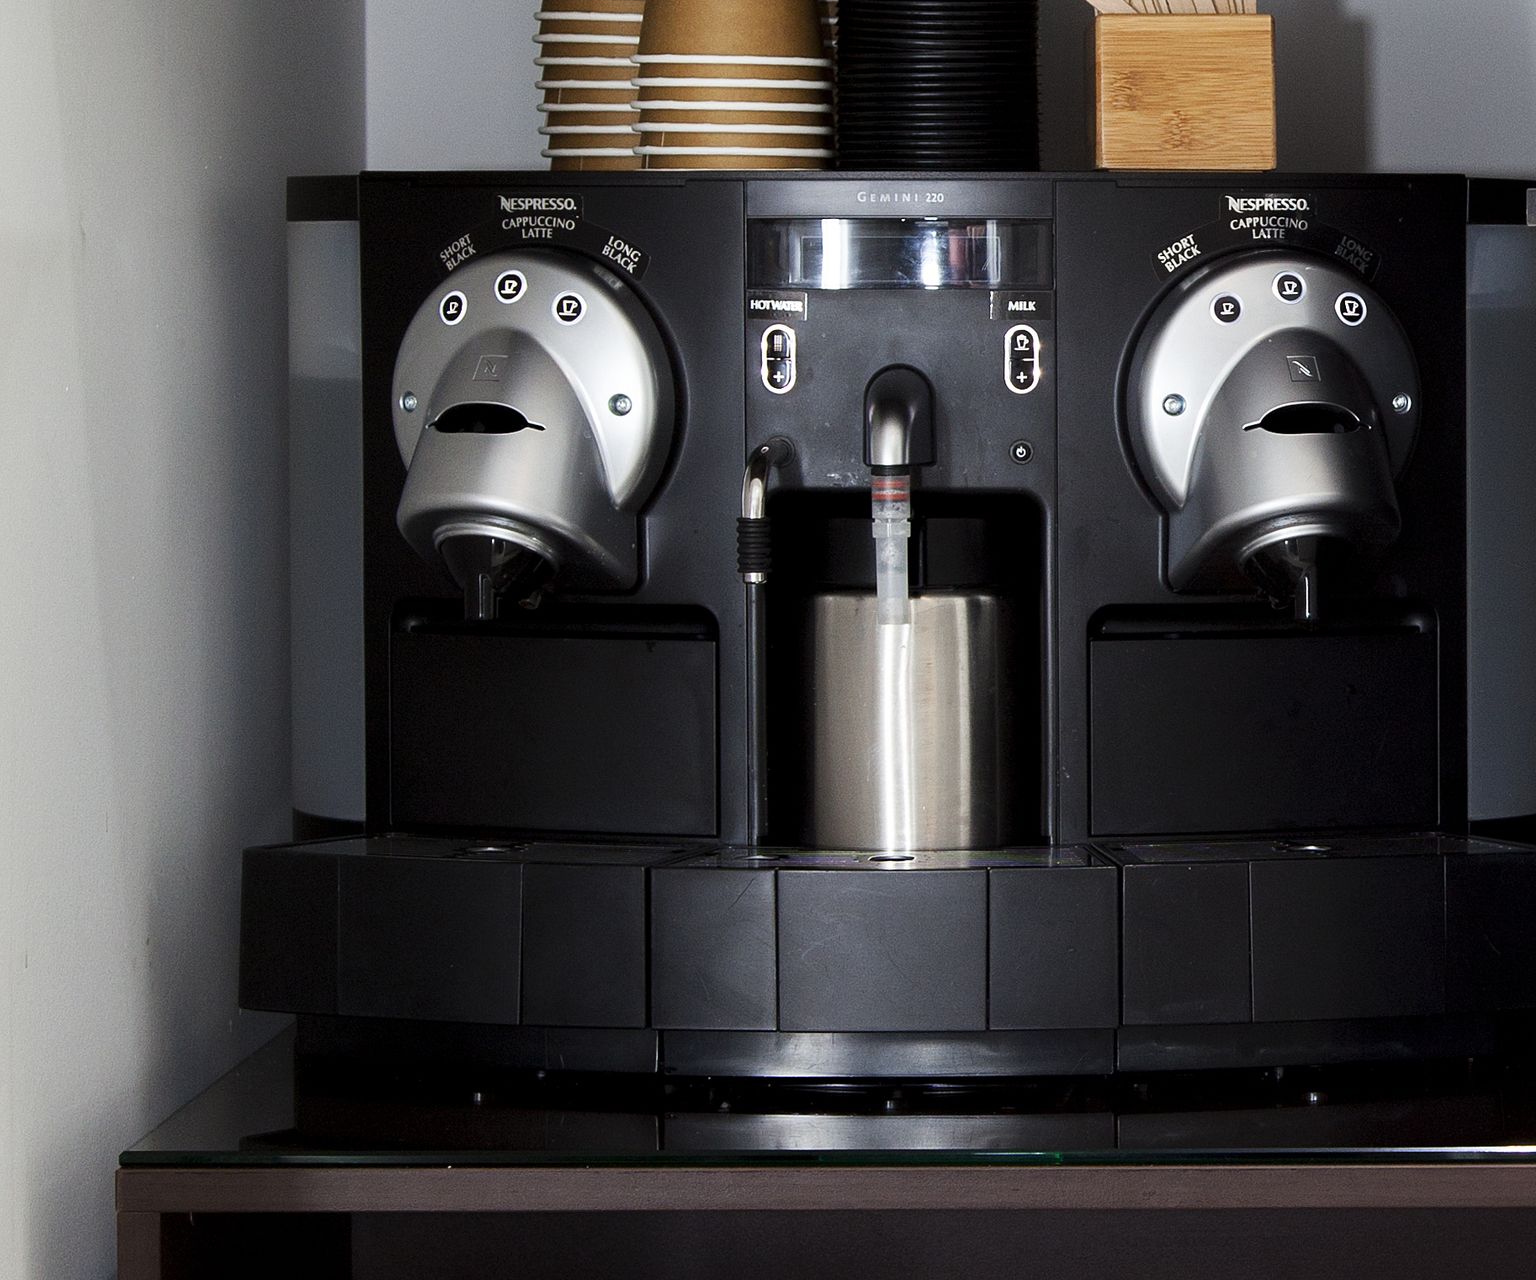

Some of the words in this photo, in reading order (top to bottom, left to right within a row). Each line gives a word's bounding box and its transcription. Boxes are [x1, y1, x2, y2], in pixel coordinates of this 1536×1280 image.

[857, 191, 919, 202] GEMINI
[926, 192, 944, 202] 220
[502, 216, 575, 230] CAPPUCCINO
[522, 228, 553, 239] LATTE
[1230, 217, 1308, 230] CAPPUCCINO
[1253, 229, 1285, 239] LATTE
[439, 233, 472, 262] SHORT
[445, 244, 477, 272] BLACK
[602, 247, 638, 274] BLACK
[608, 236, 641, 262] LONG
[1158, 234, 1195, 264] SHORT
[1165, 245, 1201, 273] BLACK
[1335, 246, 1368, 274] BLACK
[1340, 236, 1373, 262] LONG
[1008, 301, 1036, 311] MILK
